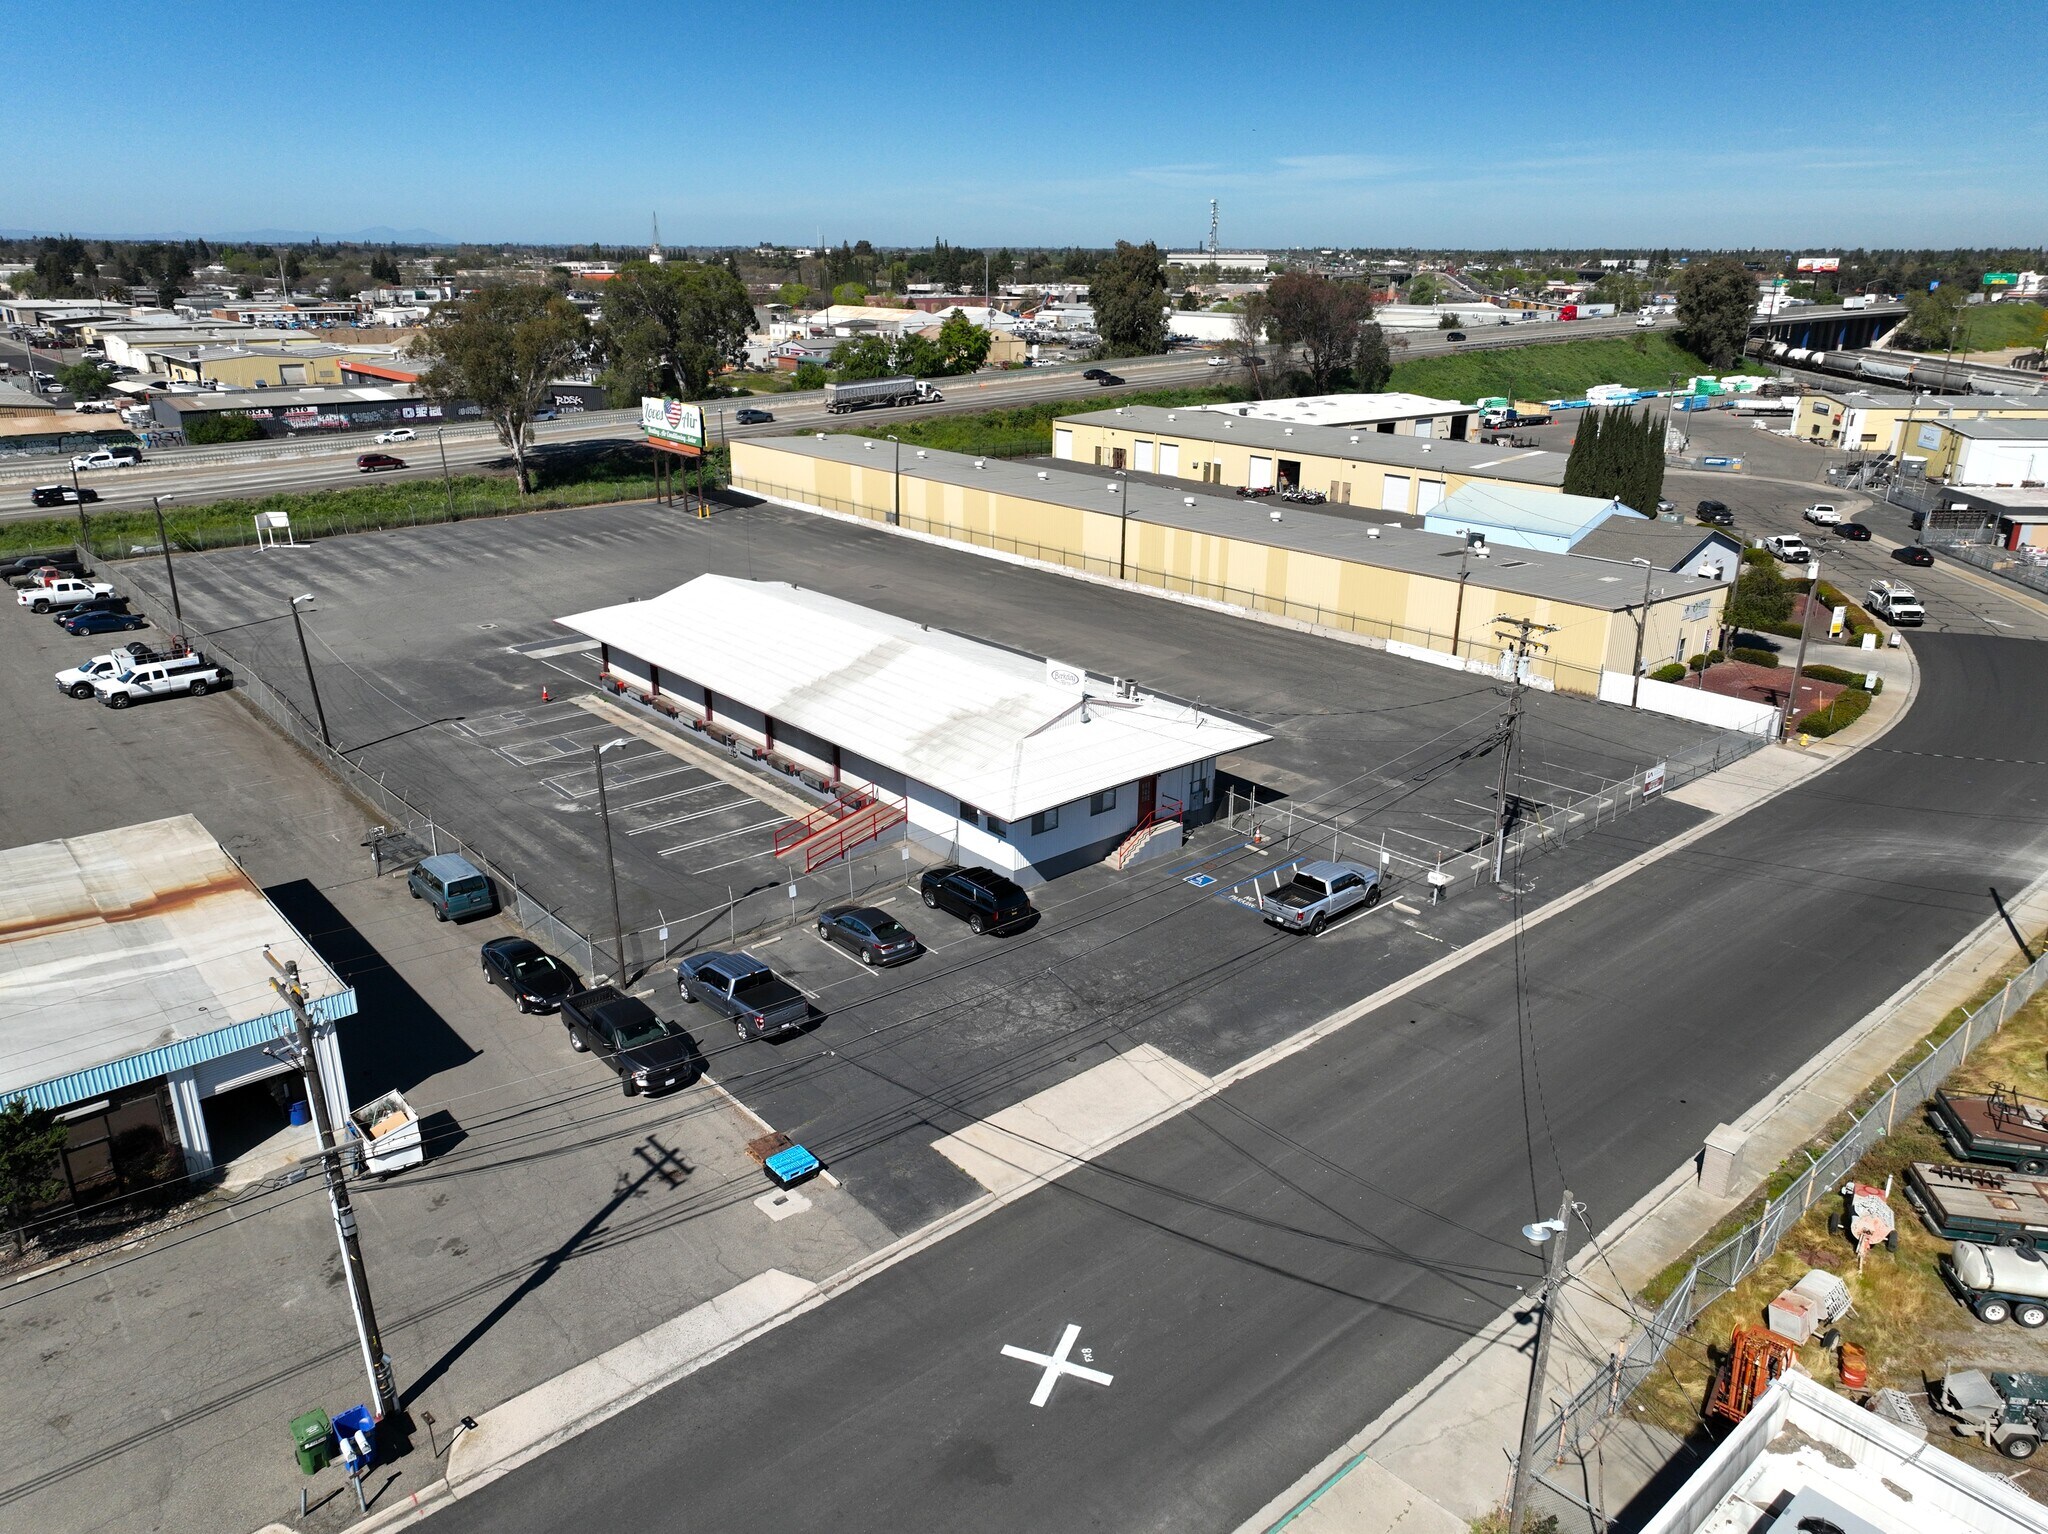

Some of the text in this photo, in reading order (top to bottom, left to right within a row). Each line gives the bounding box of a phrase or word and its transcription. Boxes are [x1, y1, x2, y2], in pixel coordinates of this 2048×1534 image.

[644, 403, 698, 429] Loves Air
[1055, 671, 1076, 682] Berkeley
[1227, 894, 1258, 908] PARKING
